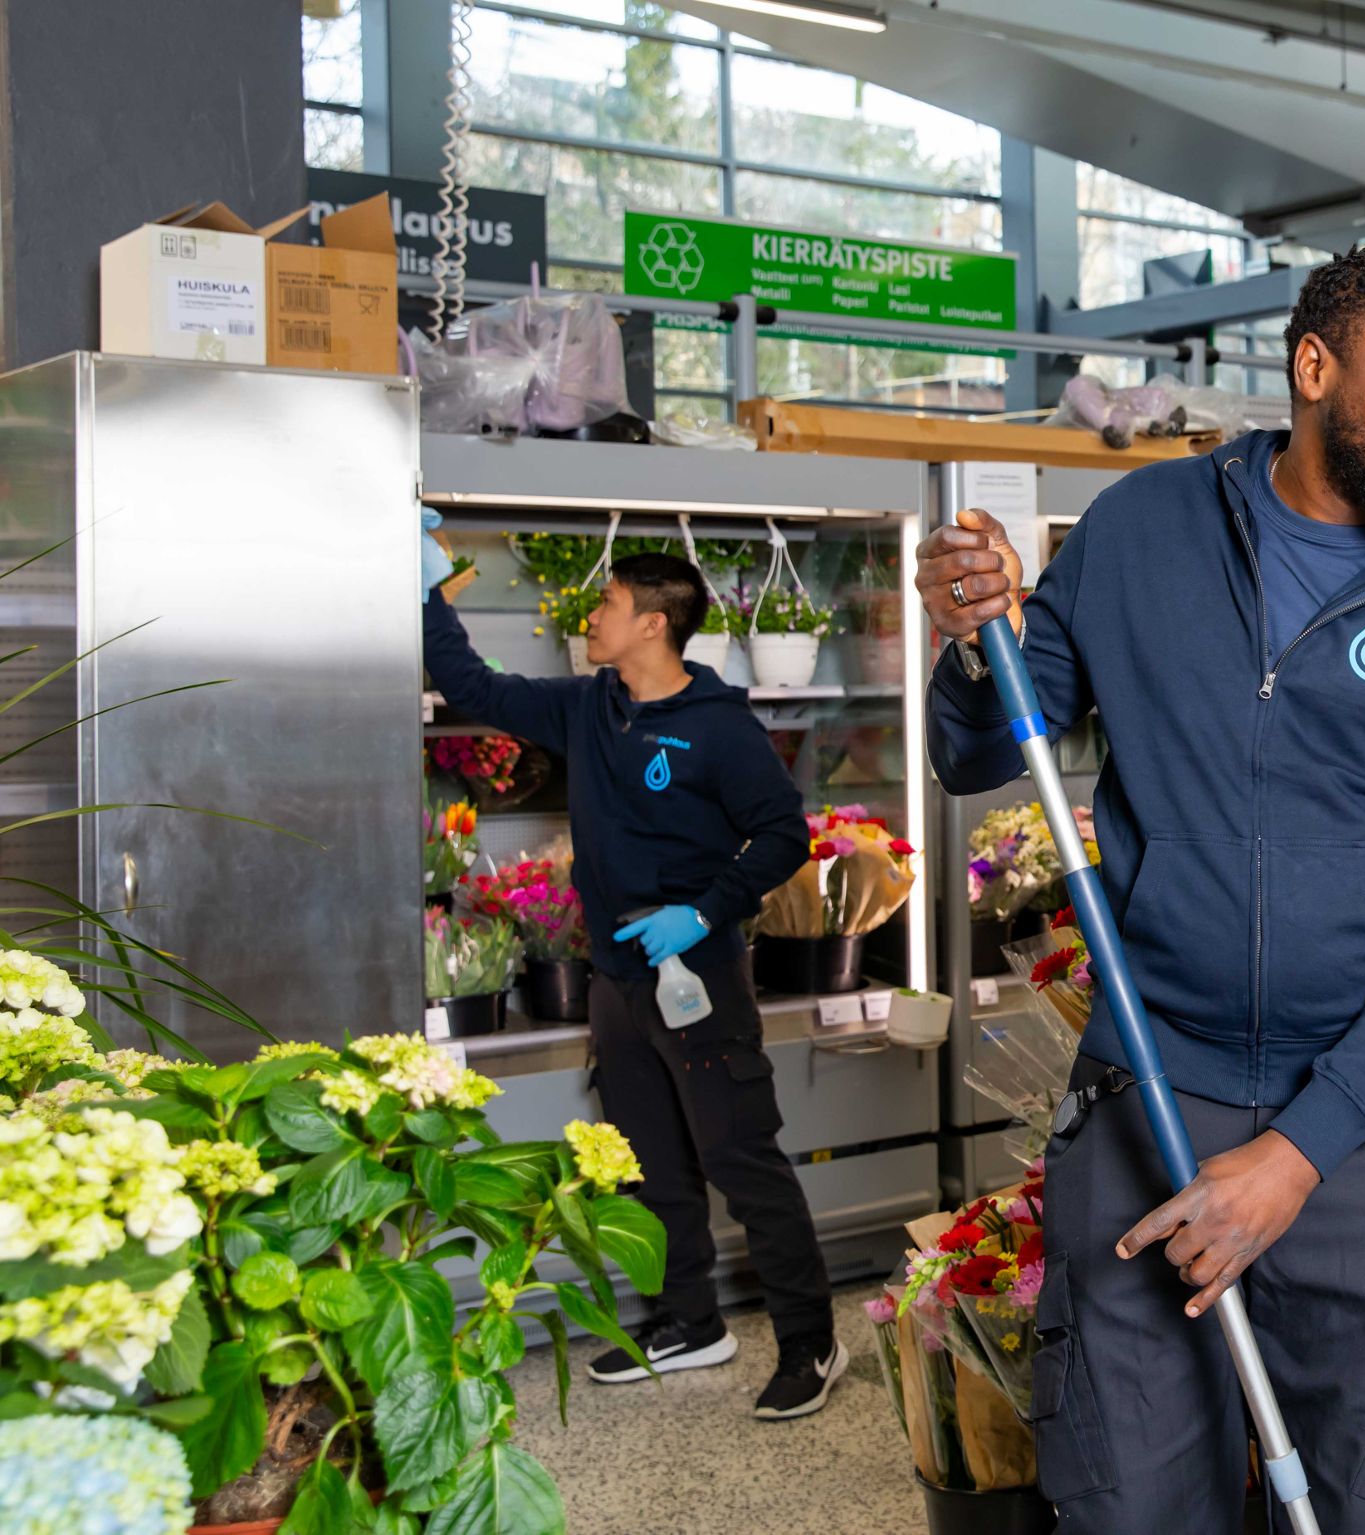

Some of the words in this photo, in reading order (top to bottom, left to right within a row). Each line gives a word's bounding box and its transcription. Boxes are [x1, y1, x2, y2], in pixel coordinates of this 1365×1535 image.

[752, 233, 953, 281] KIERRÄTYSPISTE
[751, 267, 799, 284] Vaatteet
[178, 280, 250, 294] HUISKULA
[751, 284, 791, 300] Metalli
[832, 275, 879, 293] Kartonki
[888, 281, 911, 296] Lasi
[832, 293, 868, 309] Paperi
[888, 299, 930, 315] Paristot
